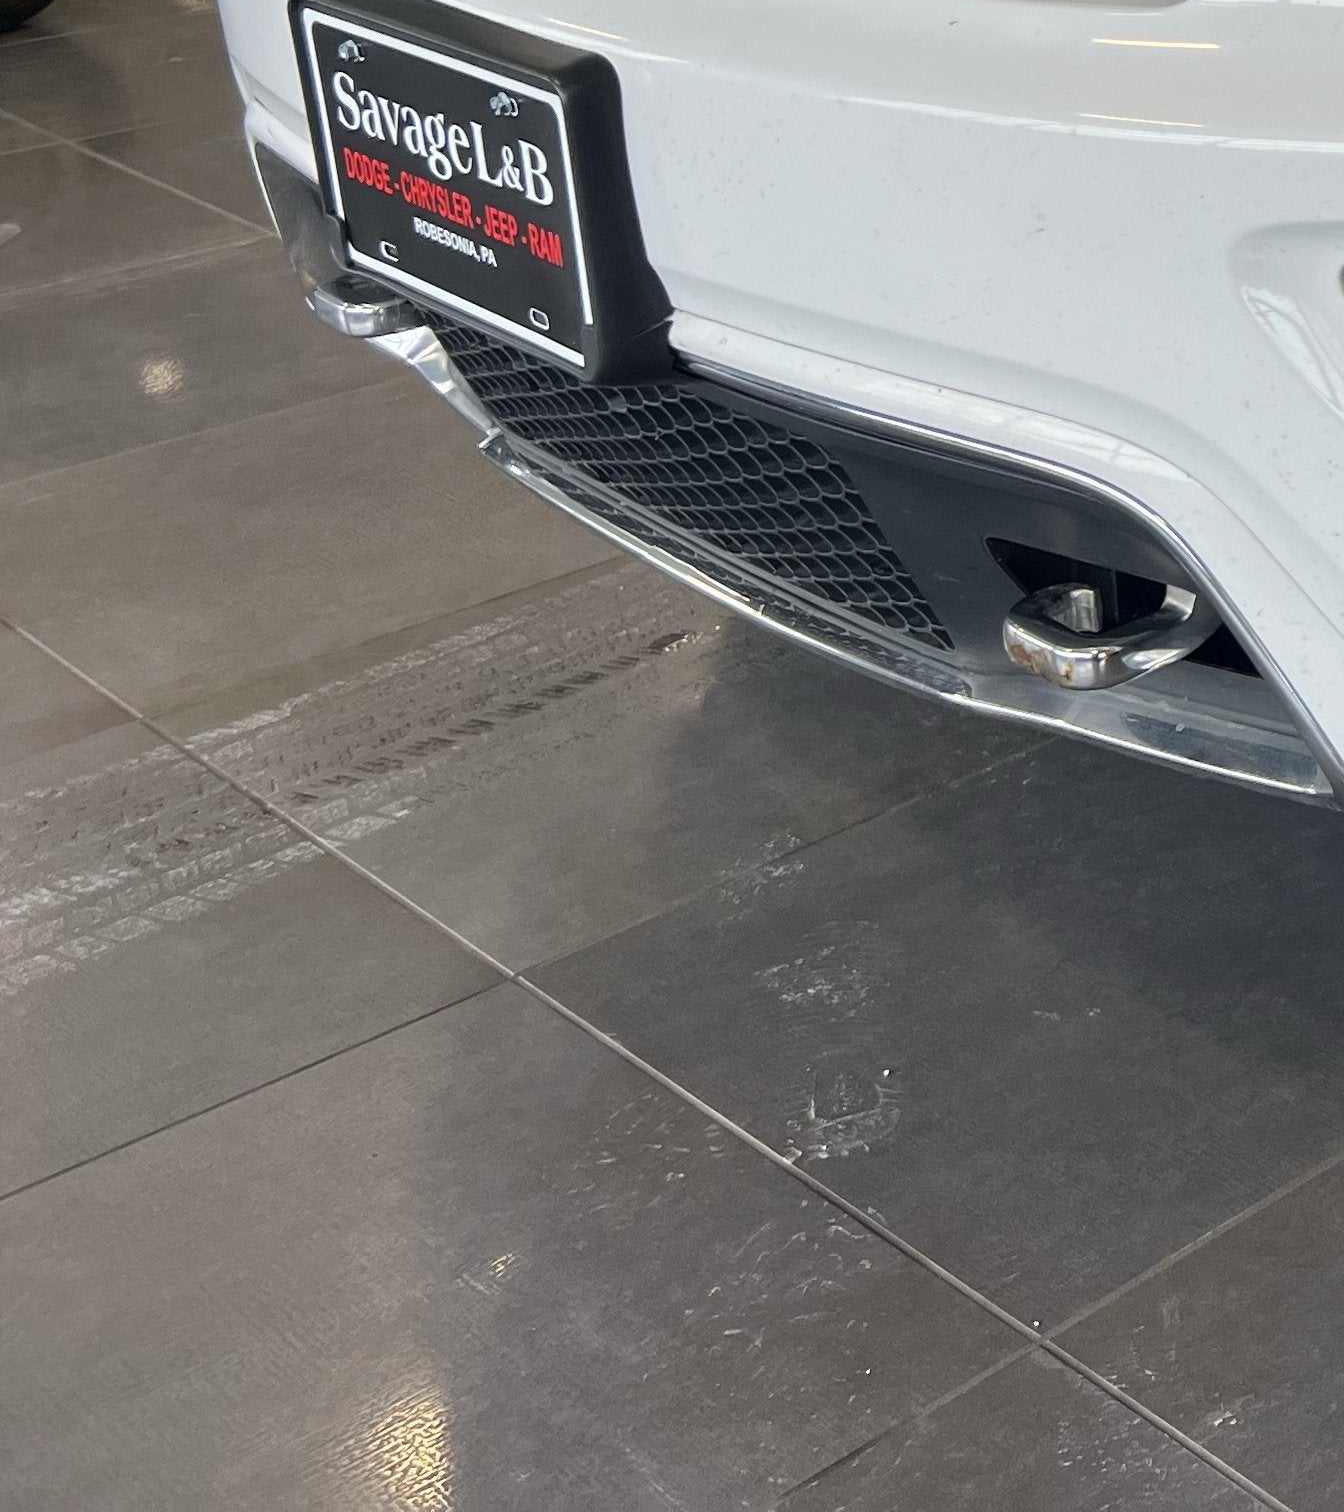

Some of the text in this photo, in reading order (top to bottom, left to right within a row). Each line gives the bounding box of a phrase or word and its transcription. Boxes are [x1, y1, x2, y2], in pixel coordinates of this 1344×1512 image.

[343, 146, 564, 267] DODGE CHRYSLER JEEP RAM
